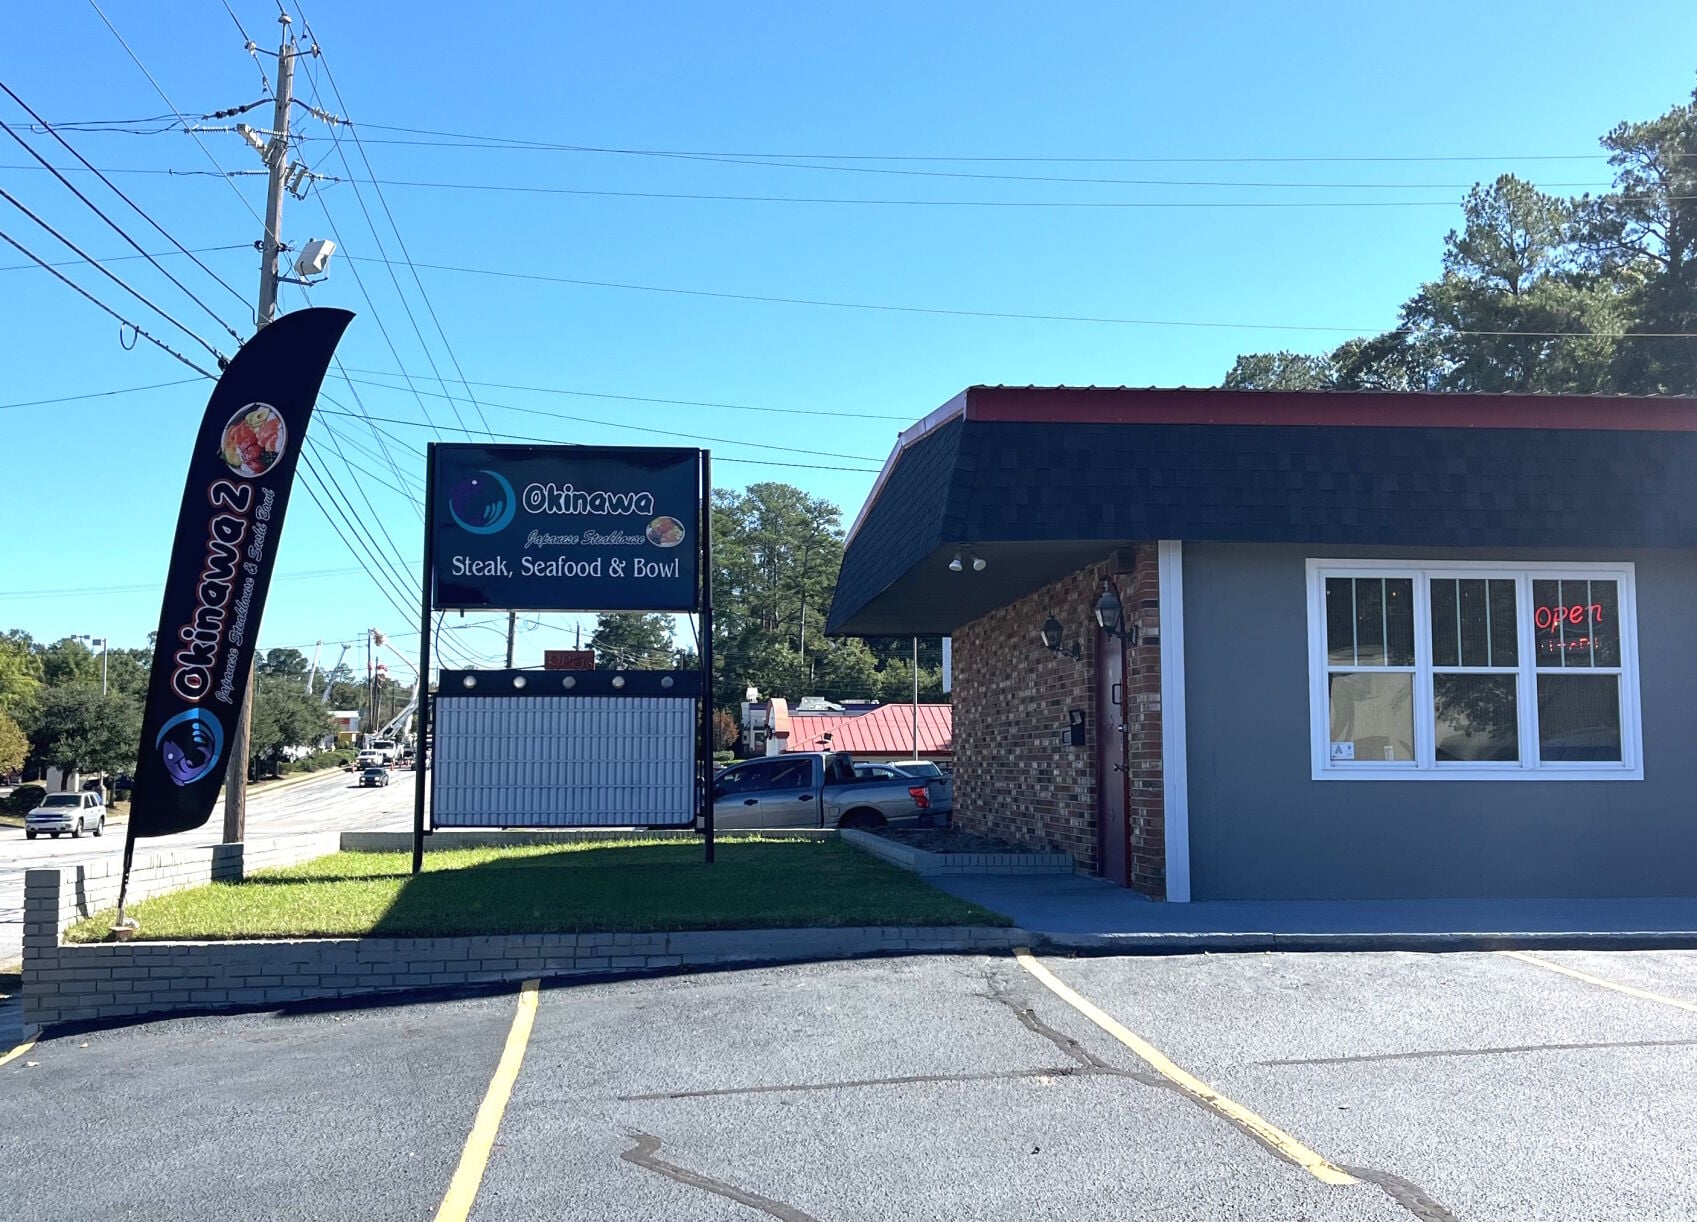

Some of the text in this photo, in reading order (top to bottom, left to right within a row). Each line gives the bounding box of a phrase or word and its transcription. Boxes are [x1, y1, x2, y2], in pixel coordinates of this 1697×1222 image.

[523, 483, 654, 515] Okinawa
[524, 529, 646, 549] Japanese Steakhouse
[452, 556, 680, 578] Steak, Seafood & Bowl
[172, 480, 252, 700] Okinawa 2
[215, 487, 275, 704] Japanese Steakhouse & Sushi Bowl
[1535, 604, 1602, 633] Open
